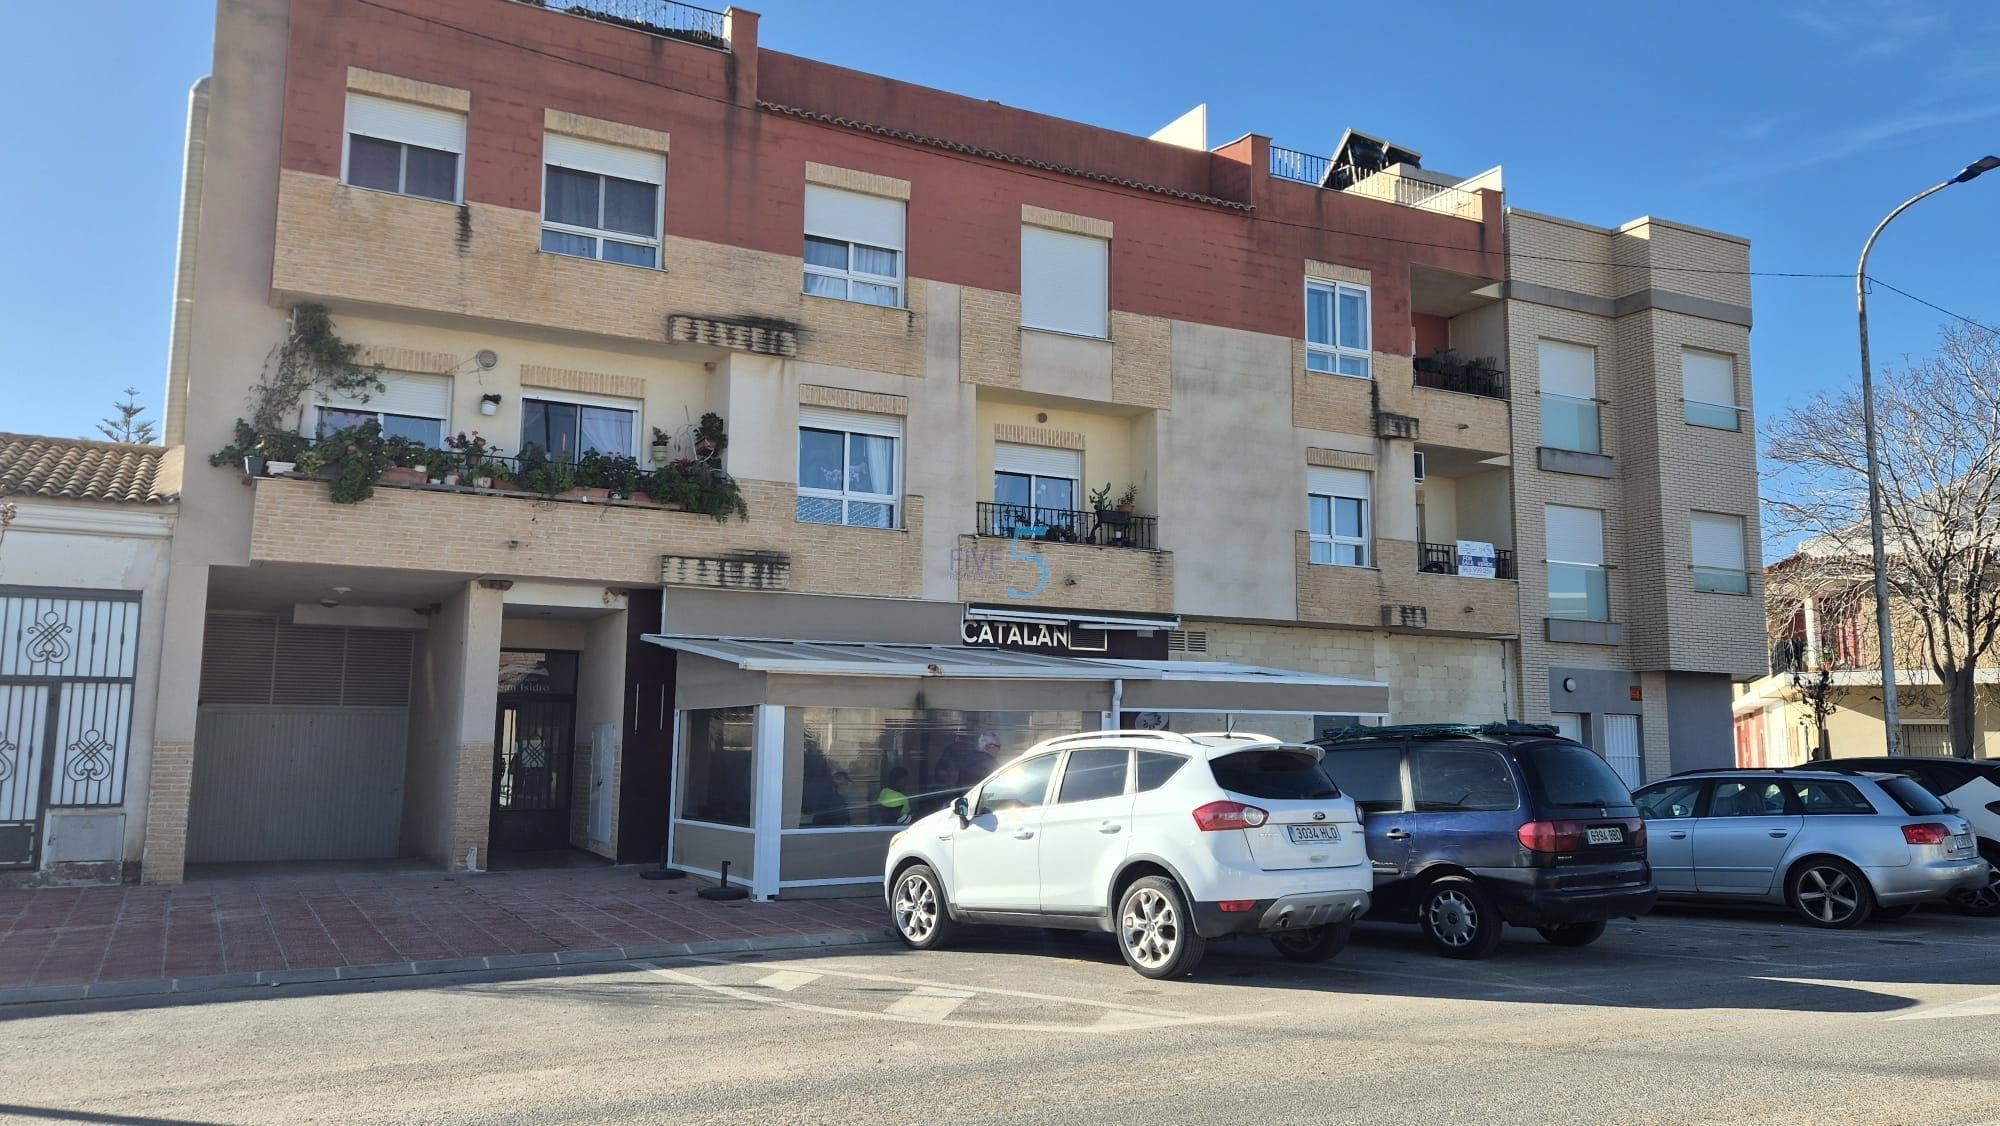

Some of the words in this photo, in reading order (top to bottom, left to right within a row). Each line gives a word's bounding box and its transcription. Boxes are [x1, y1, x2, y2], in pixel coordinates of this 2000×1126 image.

[963, 621, 1068, 647] CATALAN
[521, 683, 550, 692] Isidro
[1295, 826, 1318, 839] 3034
[1320, 826, 1338, 839] HLD
[1590, 829, 1608, 842] 6394
